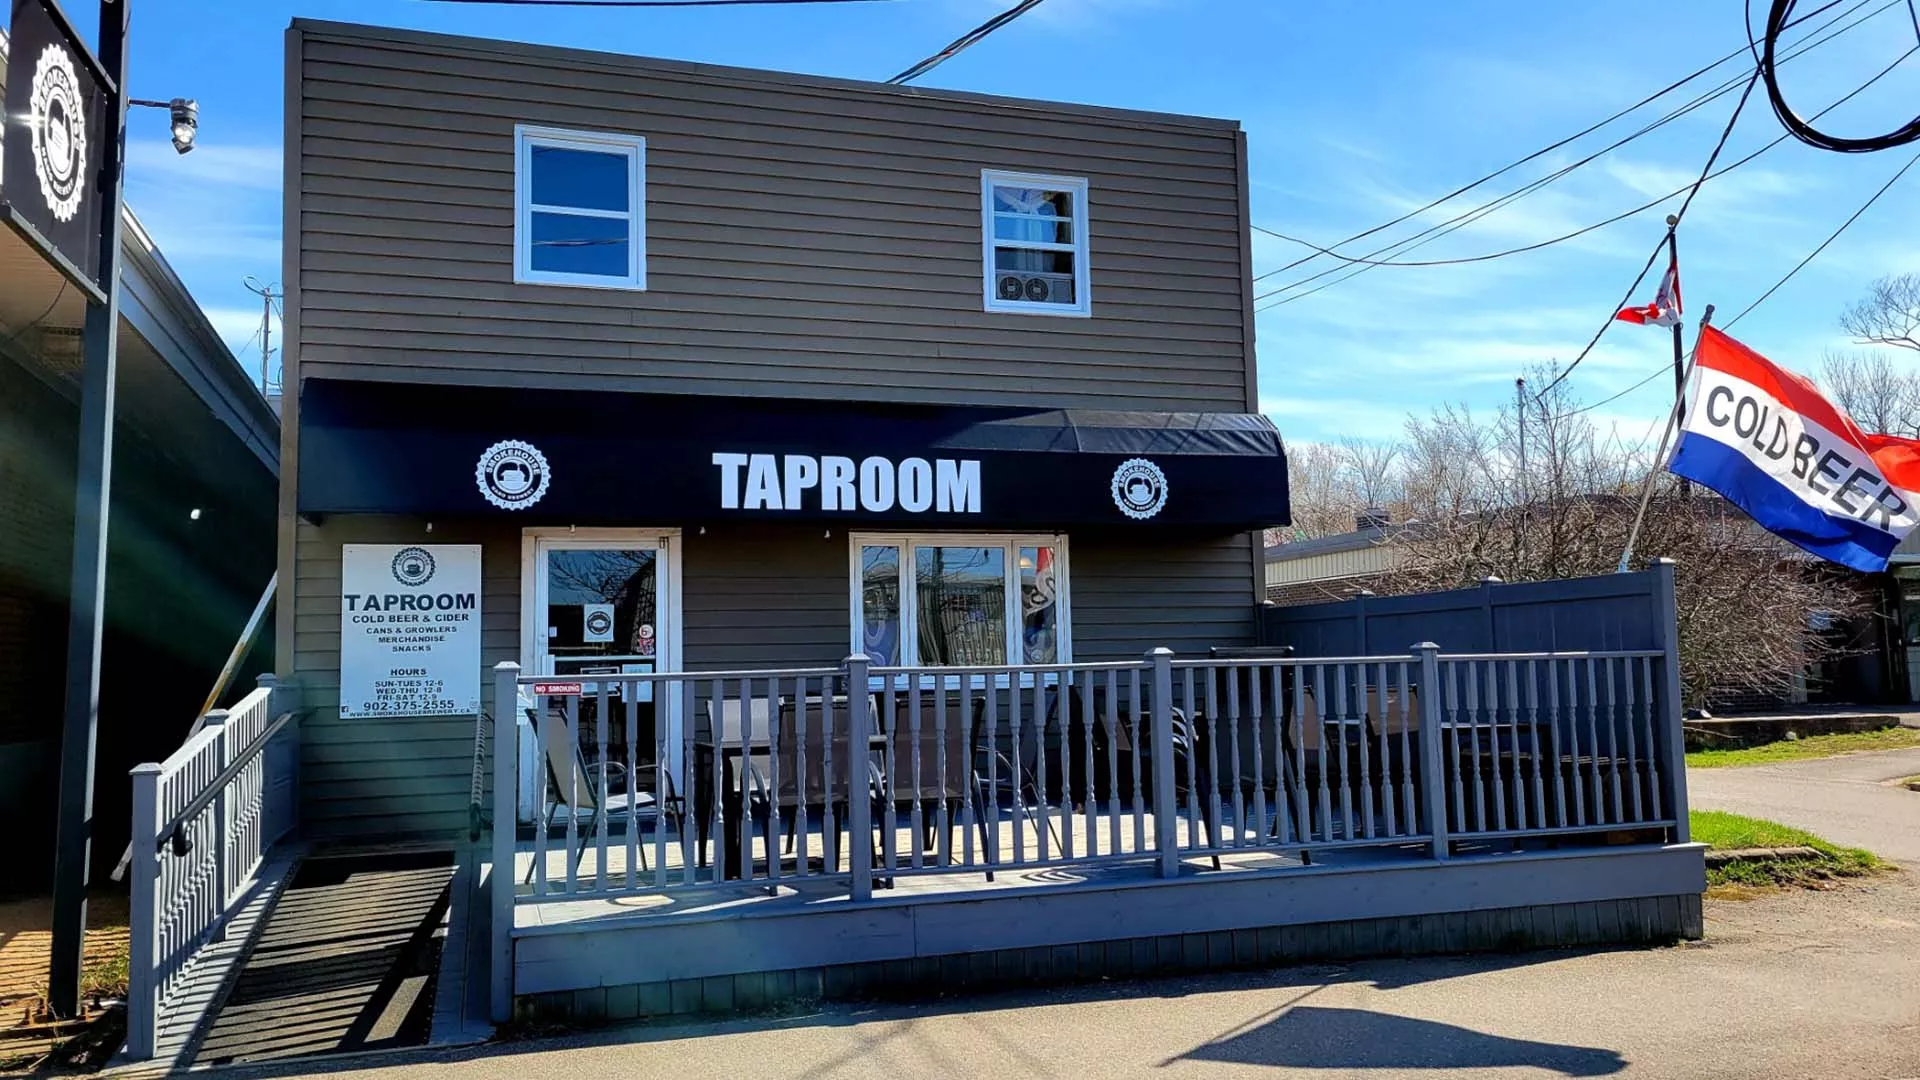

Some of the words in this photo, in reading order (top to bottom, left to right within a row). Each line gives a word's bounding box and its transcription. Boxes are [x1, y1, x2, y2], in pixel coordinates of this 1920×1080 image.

[485, 449, 541, 475] SMOKEHOUSE
[1705, 385, 1790, 461] COLD
[1791, 431, 1907, 532] BEER
[712, 452, 981, 513] TAPROOM
[1118, 466, 1160, 488] SMOKEHOUSE
[344, 593, 476, 611] TAPROOM
[352, 614, 385, 624] COLD
[388, 614, 419, 623] BEER
[422, 614, 431, 622] &
[435, 613, 469, 622] CIDER
[405, 626, 457, 634] GROWLERS
[378, 635, 446, 643] MERCHANDISE
[390, 668, 427, 676] HOURS
[535, 685, 546, 693] NO
[548, 684, 580, 693] SMOKING
[363, 700, 455, 711] 902-375-2555
